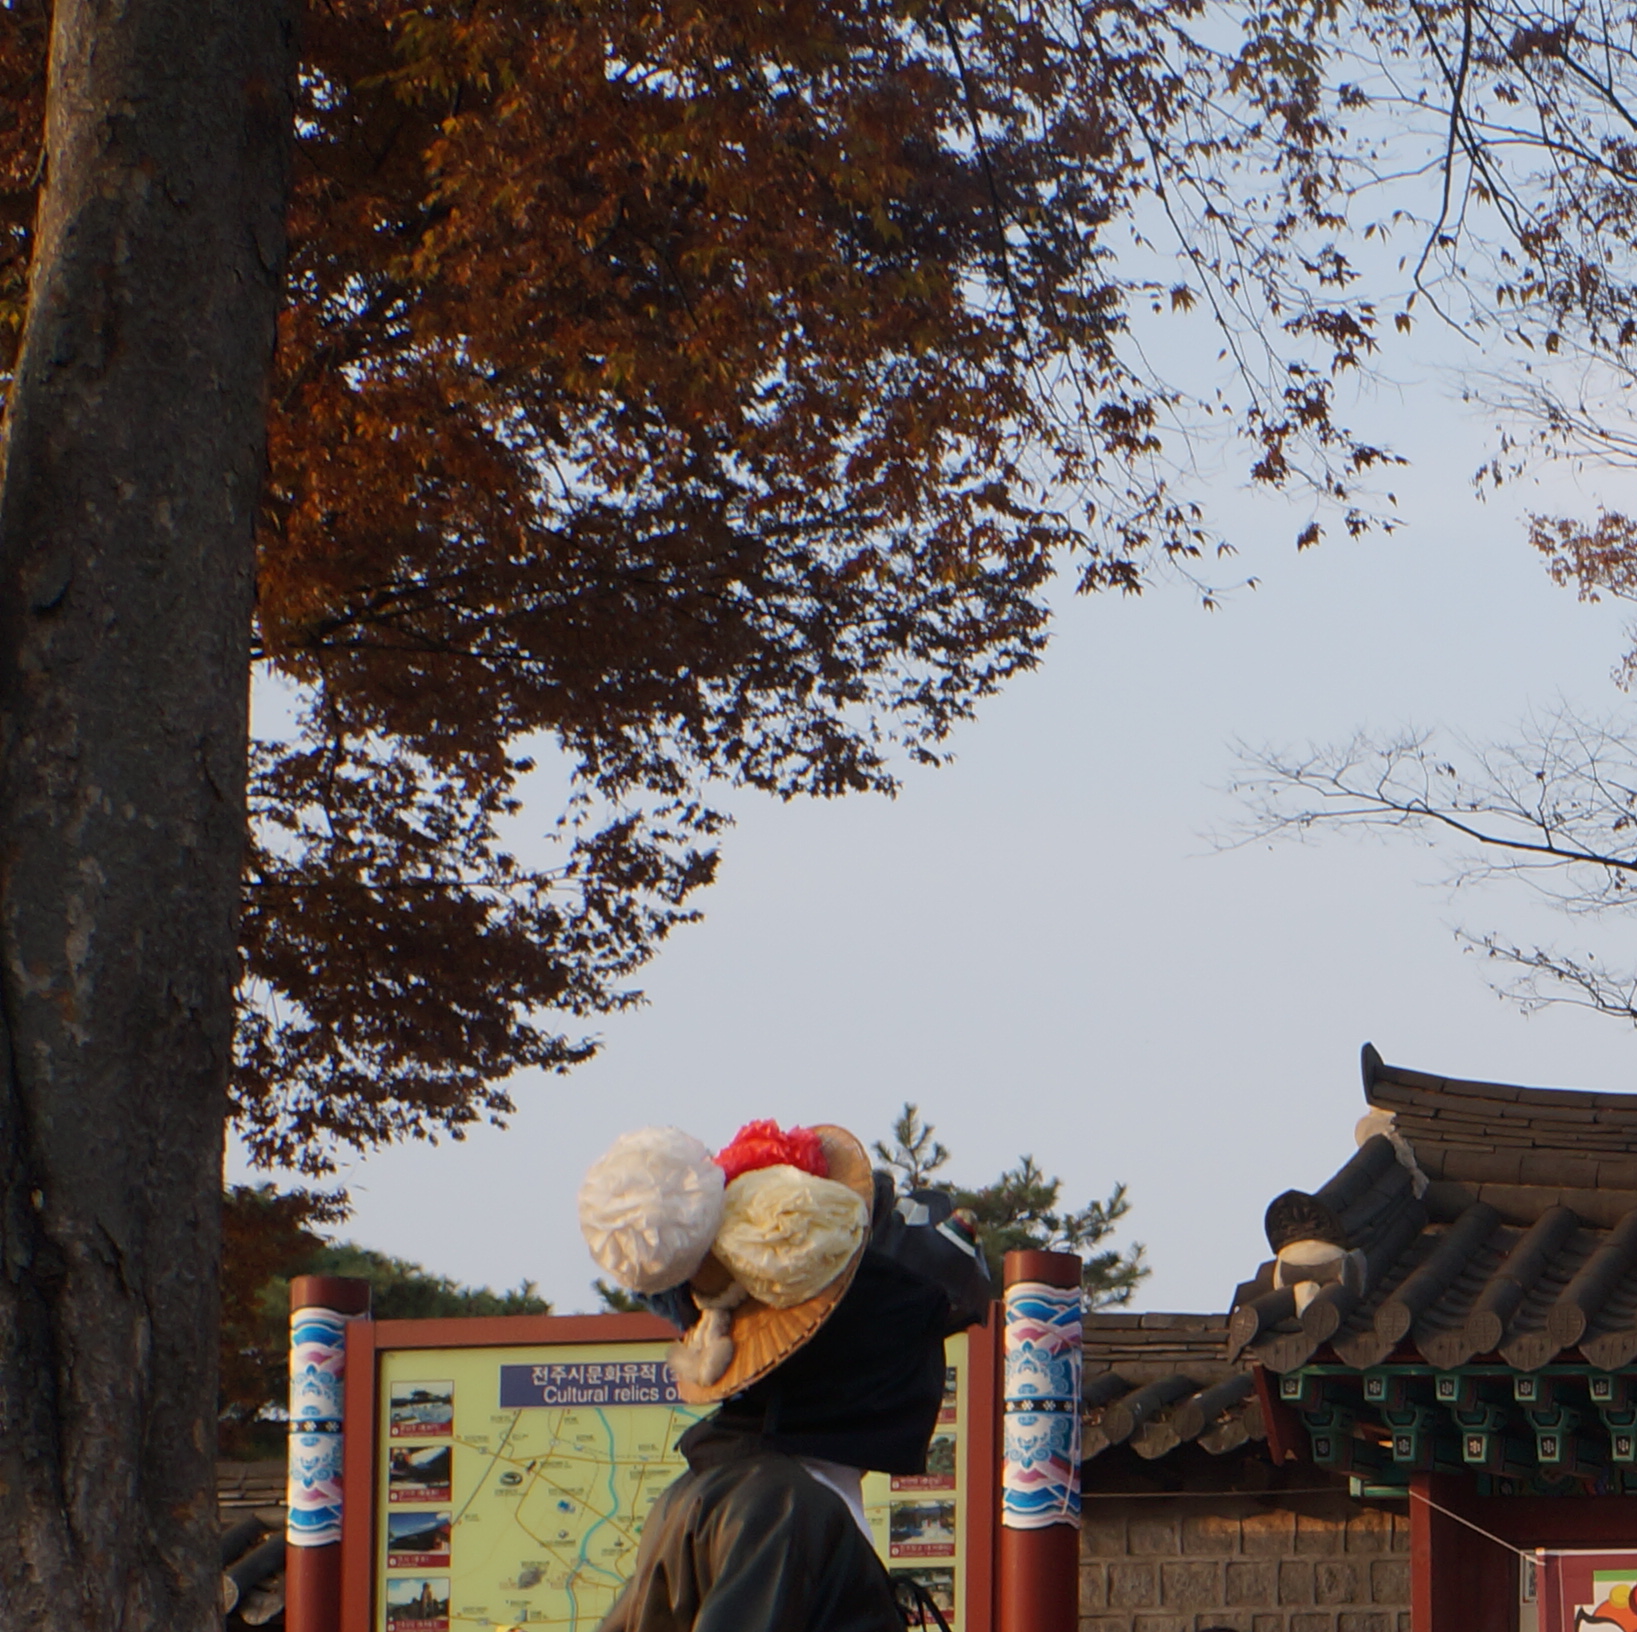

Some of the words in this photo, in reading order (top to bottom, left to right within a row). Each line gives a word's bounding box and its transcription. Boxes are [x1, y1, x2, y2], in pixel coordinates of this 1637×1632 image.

[532, 1363, 656, 1386] 전주시문화유적
[543, 1385, 609, 1404] Cultural
[614, 1384, 660, 1402] relics
